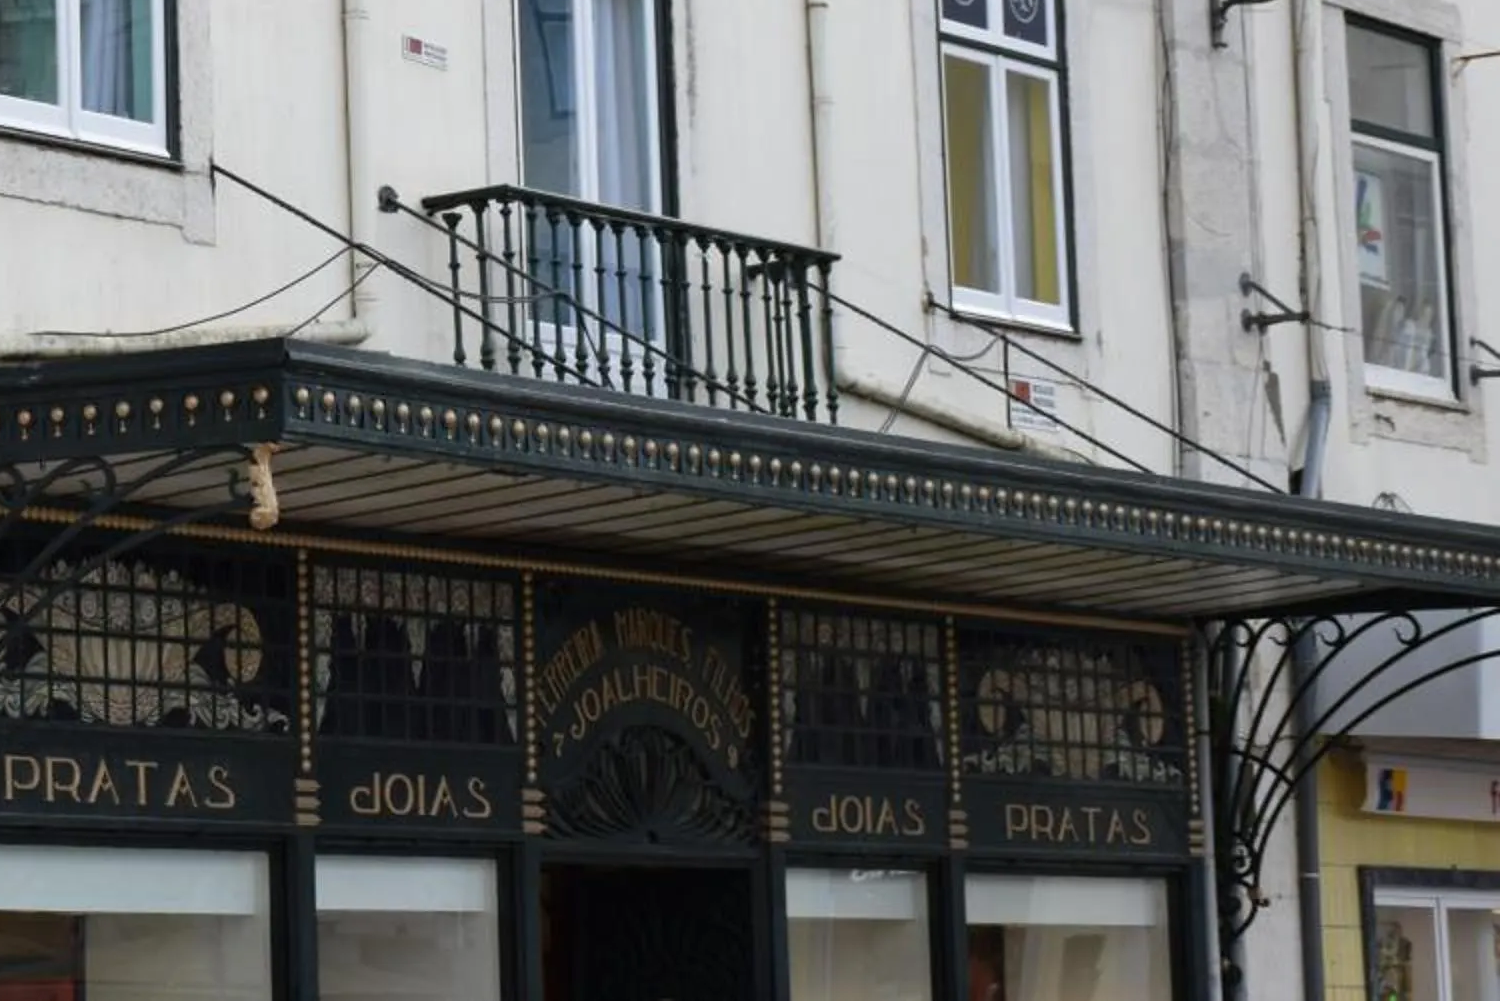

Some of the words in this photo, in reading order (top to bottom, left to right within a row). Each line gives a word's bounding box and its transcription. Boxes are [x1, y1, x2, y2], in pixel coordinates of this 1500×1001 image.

[569, 663, 723, 751] JOALHEIROS
[4, 754, 236, 809] PRATAS
[349, 771, 491, 818] JOIAS
[812, 794, 926, 835] JOIAS
[1004, 803, 1152, 845] PRATAS
